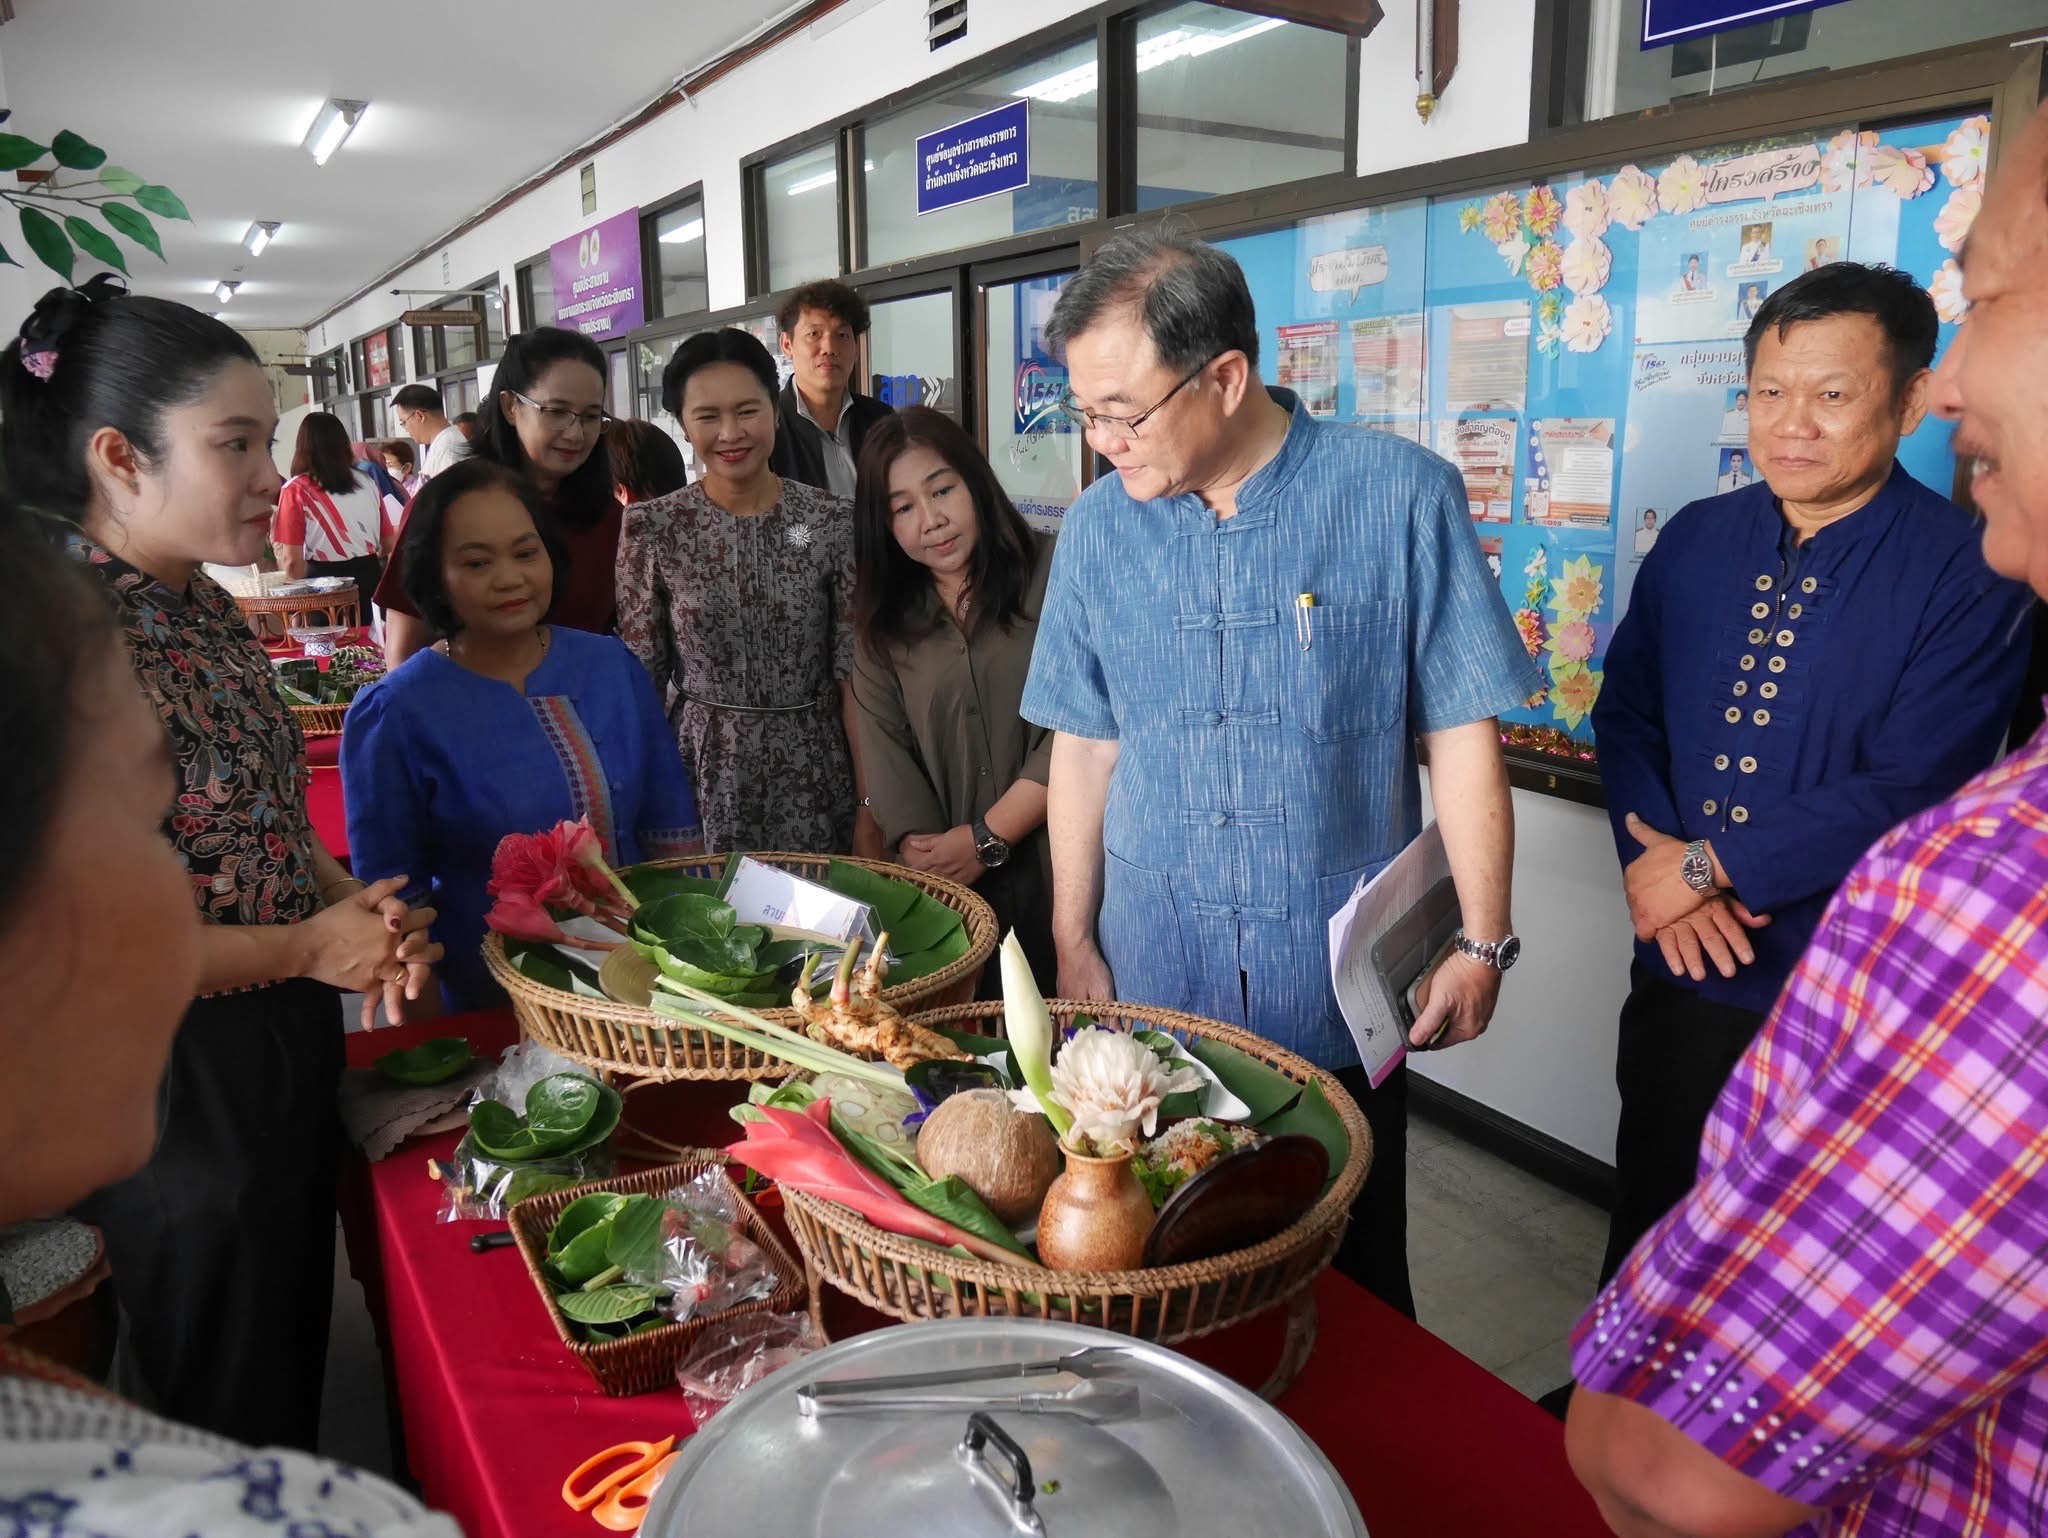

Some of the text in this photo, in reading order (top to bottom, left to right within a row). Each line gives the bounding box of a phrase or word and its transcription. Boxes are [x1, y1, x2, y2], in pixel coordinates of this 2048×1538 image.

[925, 126, 1017, 171] ศูนย์ข้อมูลข่าวสารของราชการ
[925, 152, 1018, 190] สำนักงานจังหวัดฉะเชิงเทรา
[1708, 154, 1817, 193] โครงสร้าง
[1645, 360, 1666, 369] 1567
[1024, 382, 1063, 416] 1567
